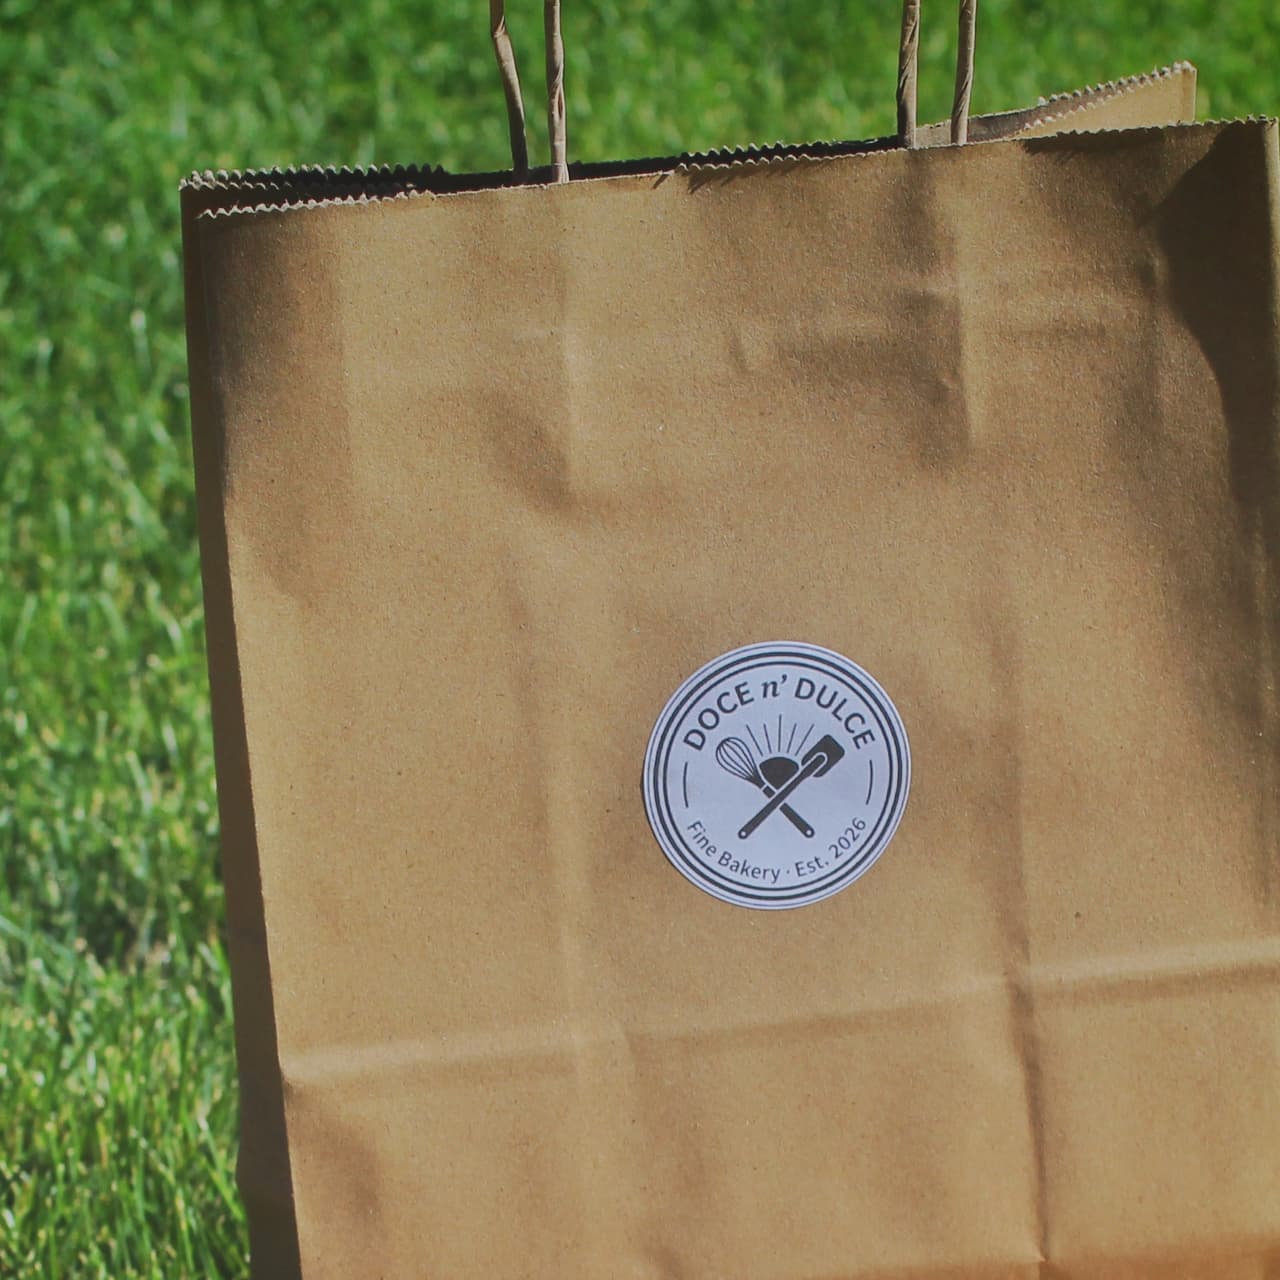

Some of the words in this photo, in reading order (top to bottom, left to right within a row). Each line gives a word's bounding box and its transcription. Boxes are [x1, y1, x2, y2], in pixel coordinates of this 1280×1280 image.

[683, 682, 754, 751] DOCE
[794, 678, 876, 750] DULCE
[687, 820, 717, 857] Fine
[717, 851, 780, 883] Bakery
[795, 856, 829, 877] Est.
[828, 817, 866, 858] 2026
